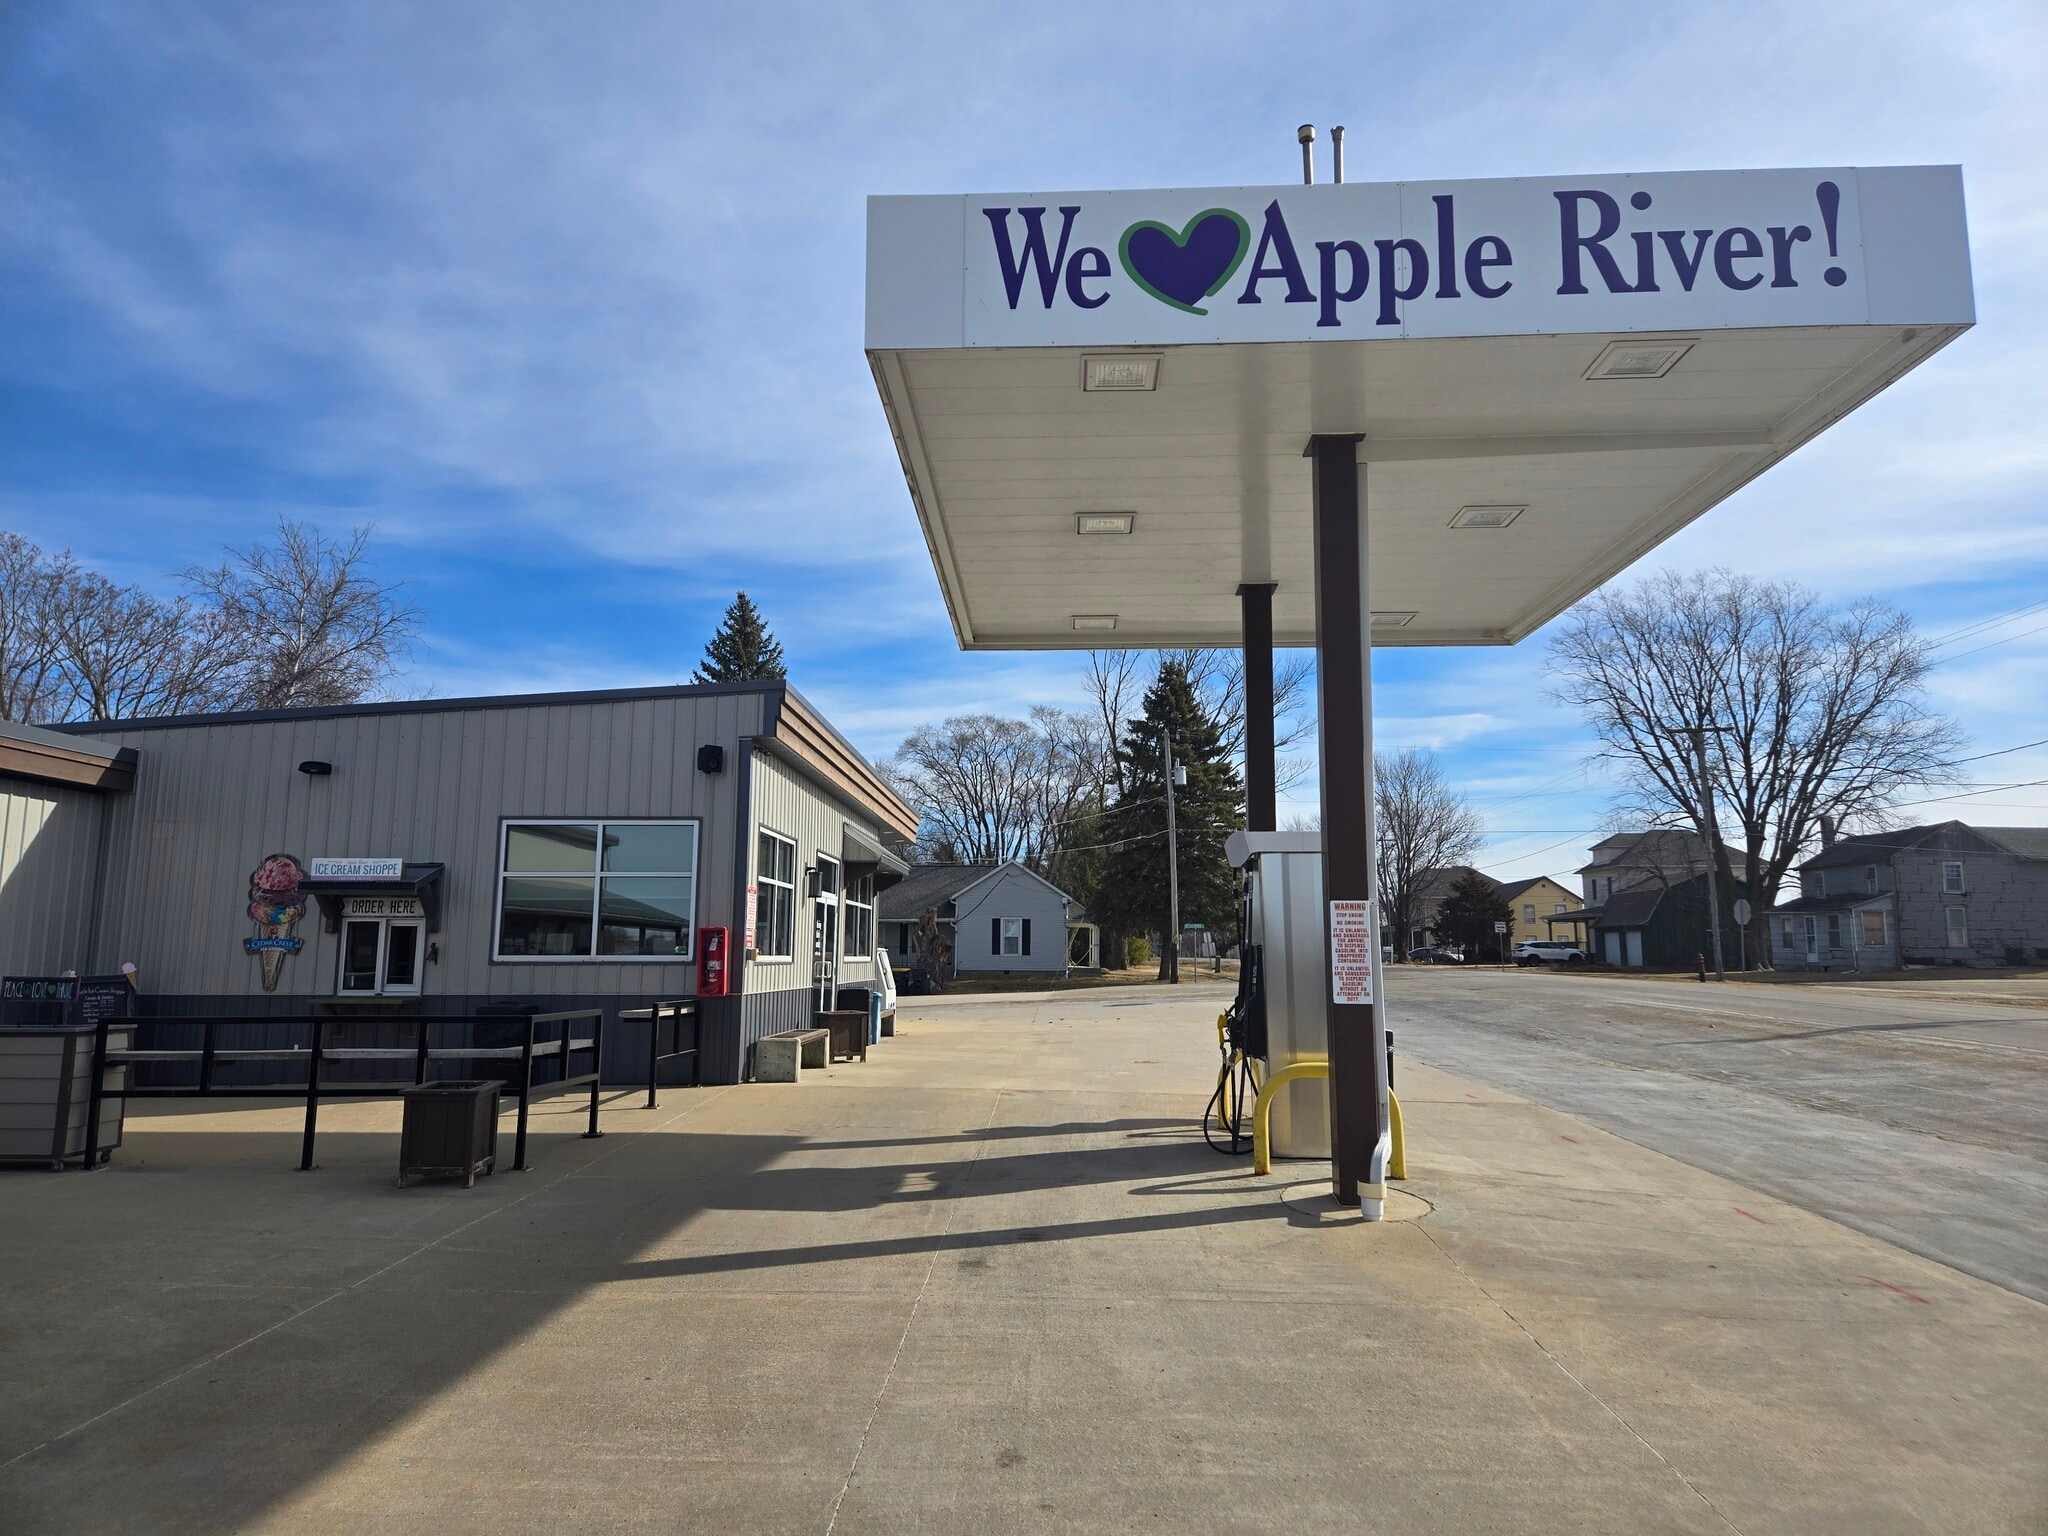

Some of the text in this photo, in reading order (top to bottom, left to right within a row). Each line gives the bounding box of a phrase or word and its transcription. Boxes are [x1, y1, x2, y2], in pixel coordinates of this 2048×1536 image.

[983, 182, 1846, 326] We Apple River!
[315, 863, 398, 875] ICE CREAM SHOPPE
[352, 900, 416, 913] ORDER HERE
[1333, 902, 1366, 910] WARNING
[251, 939, 294, 948] CEDAR CREST
[4, 981, 24, 998] PEACE
[31, 981, 48, 998] LOVE
